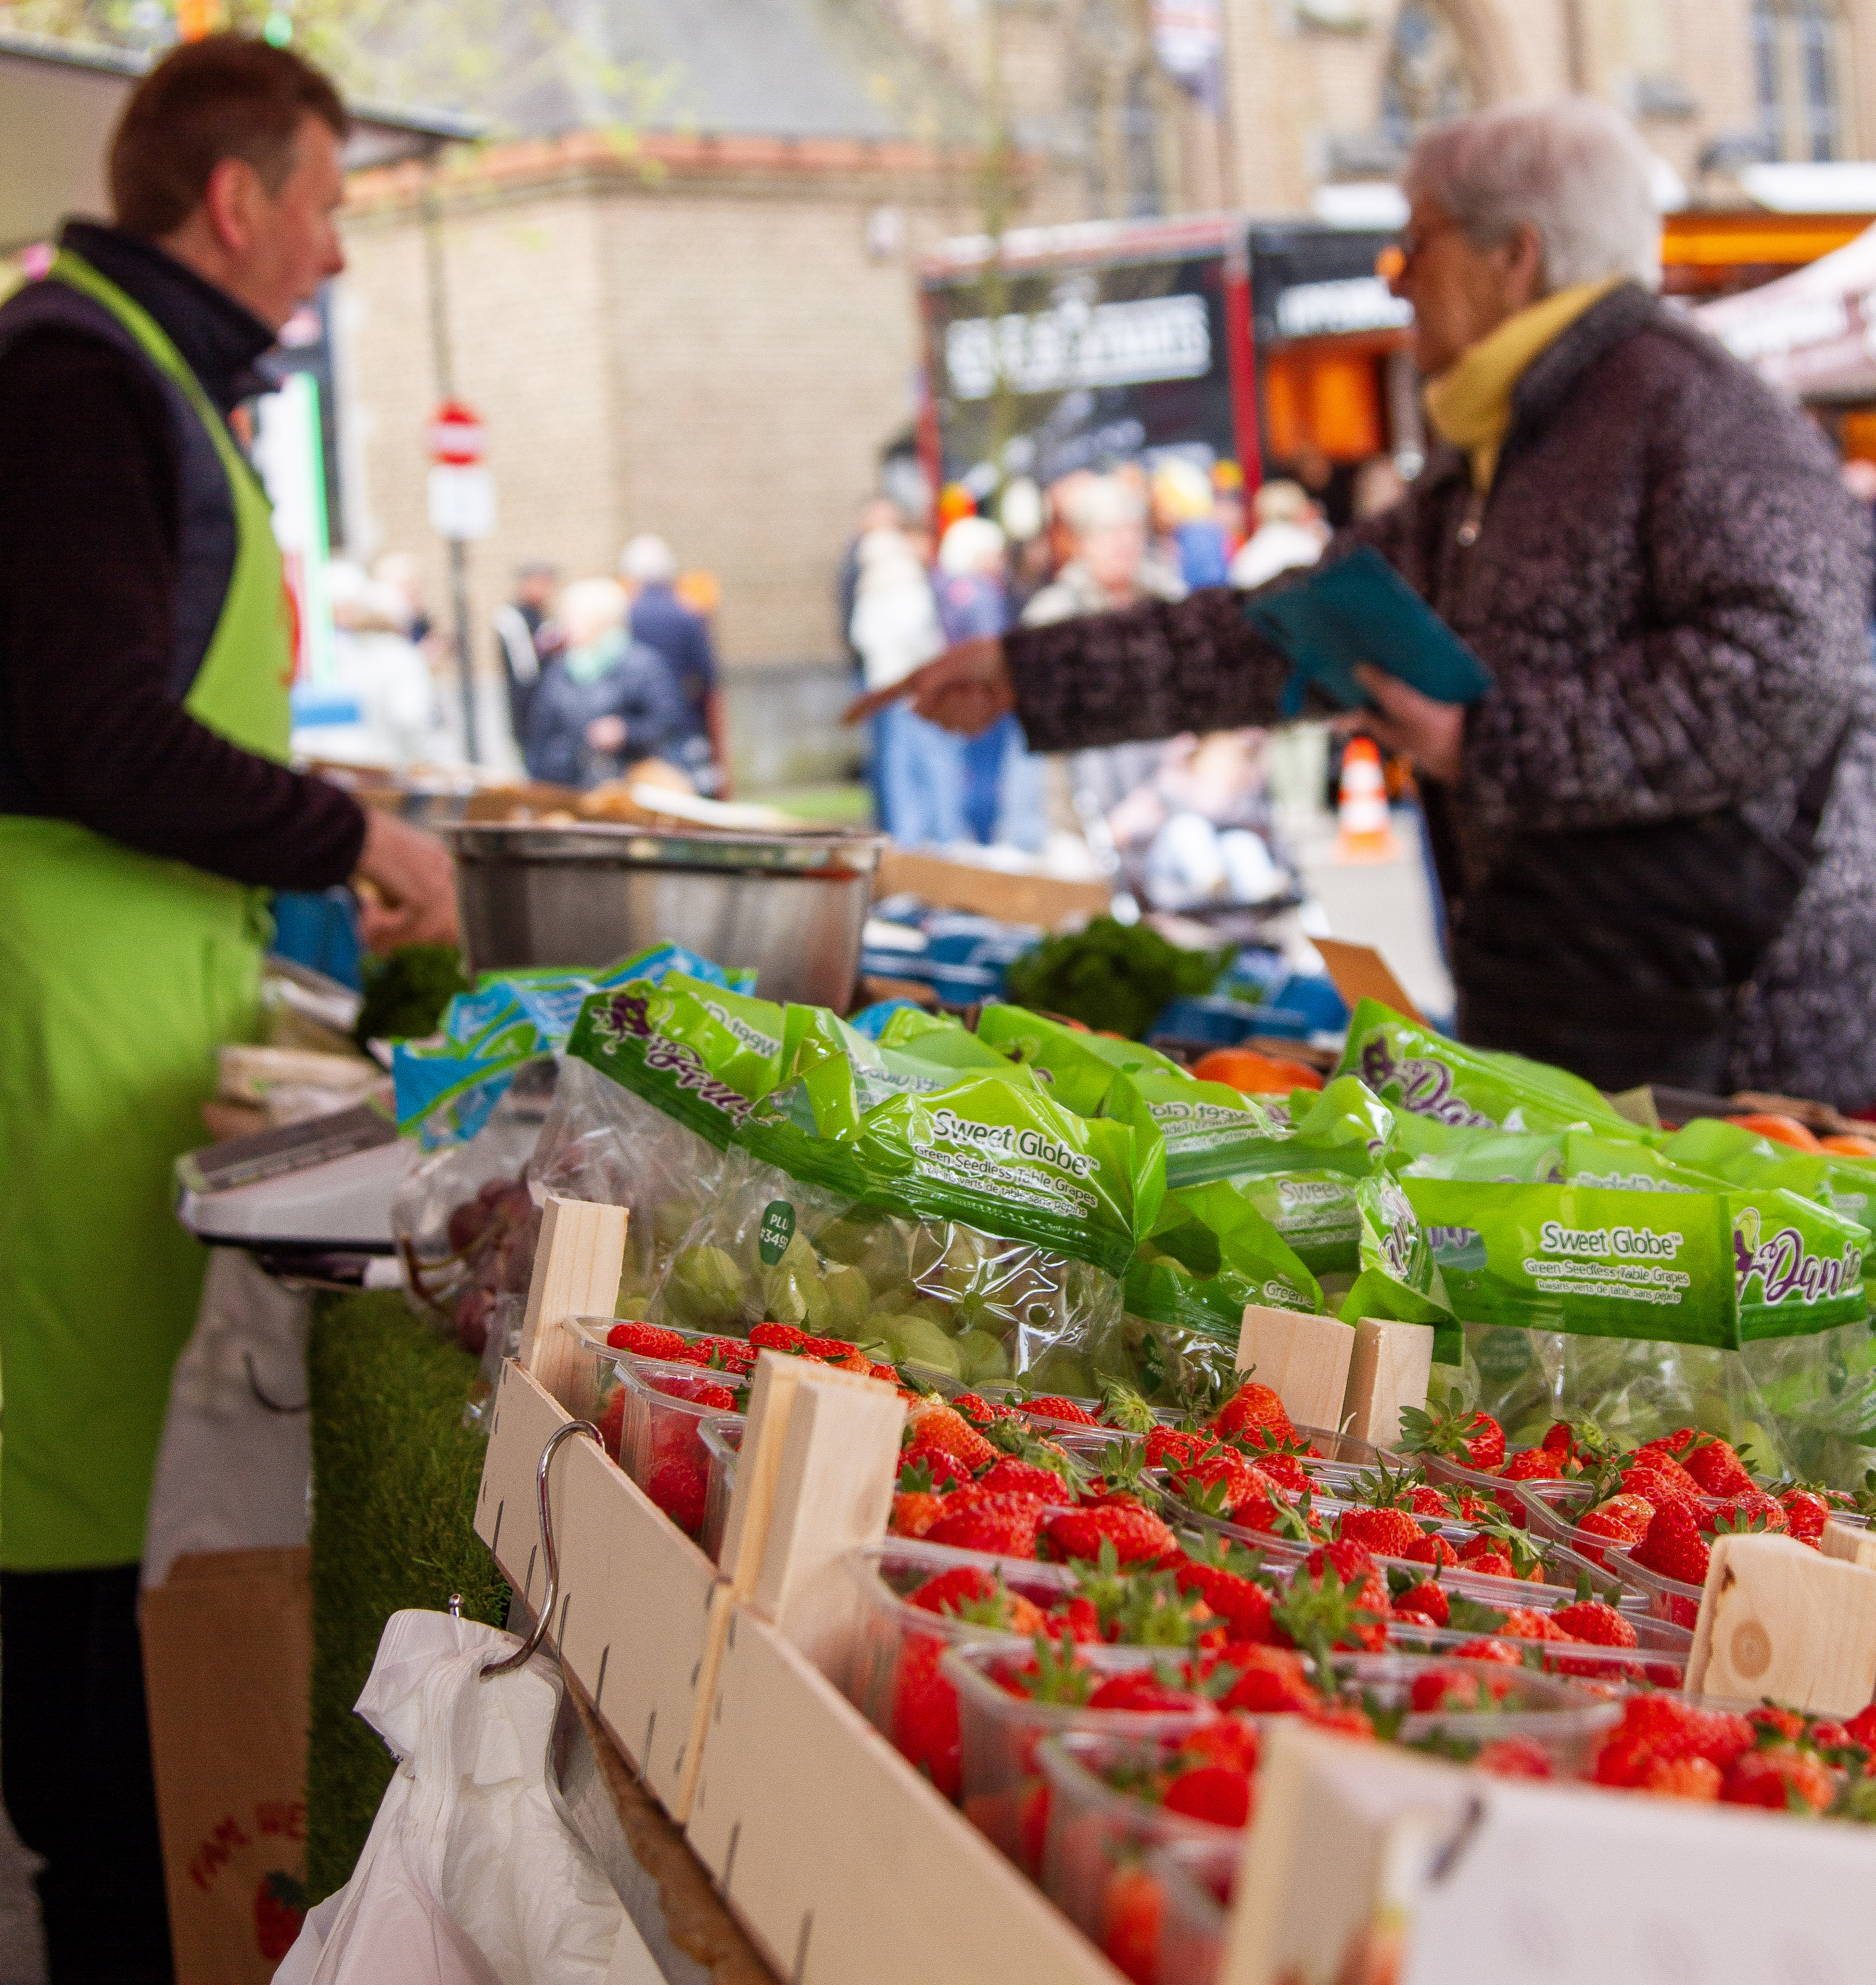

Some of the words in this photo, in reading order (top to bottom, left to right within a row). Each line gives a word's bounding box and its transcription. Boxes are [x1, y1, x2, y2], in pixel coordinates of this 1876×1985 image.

[933, 1111, 1013, 1150] Sweet
[915, 1146, 950, 1164] Green
[956, 1155, 1012, 1179] Seedless
[1018, 1168, 1051, 1188] Table
[1055, 1179, 1096, 1205] Grapes
[986, 1182, 999, 1193] de
[770, 1213, 789, 1230] PLU
[1544, 1224, 1608, 1252] Sweet
[1526, 1260, 1561, 1274] Green
[1565, 1261, 1616, 1276] Seedless
[1620, 1267, 1650, 1281] Table
[1654, 1268, 1689, 1285] Grapes
